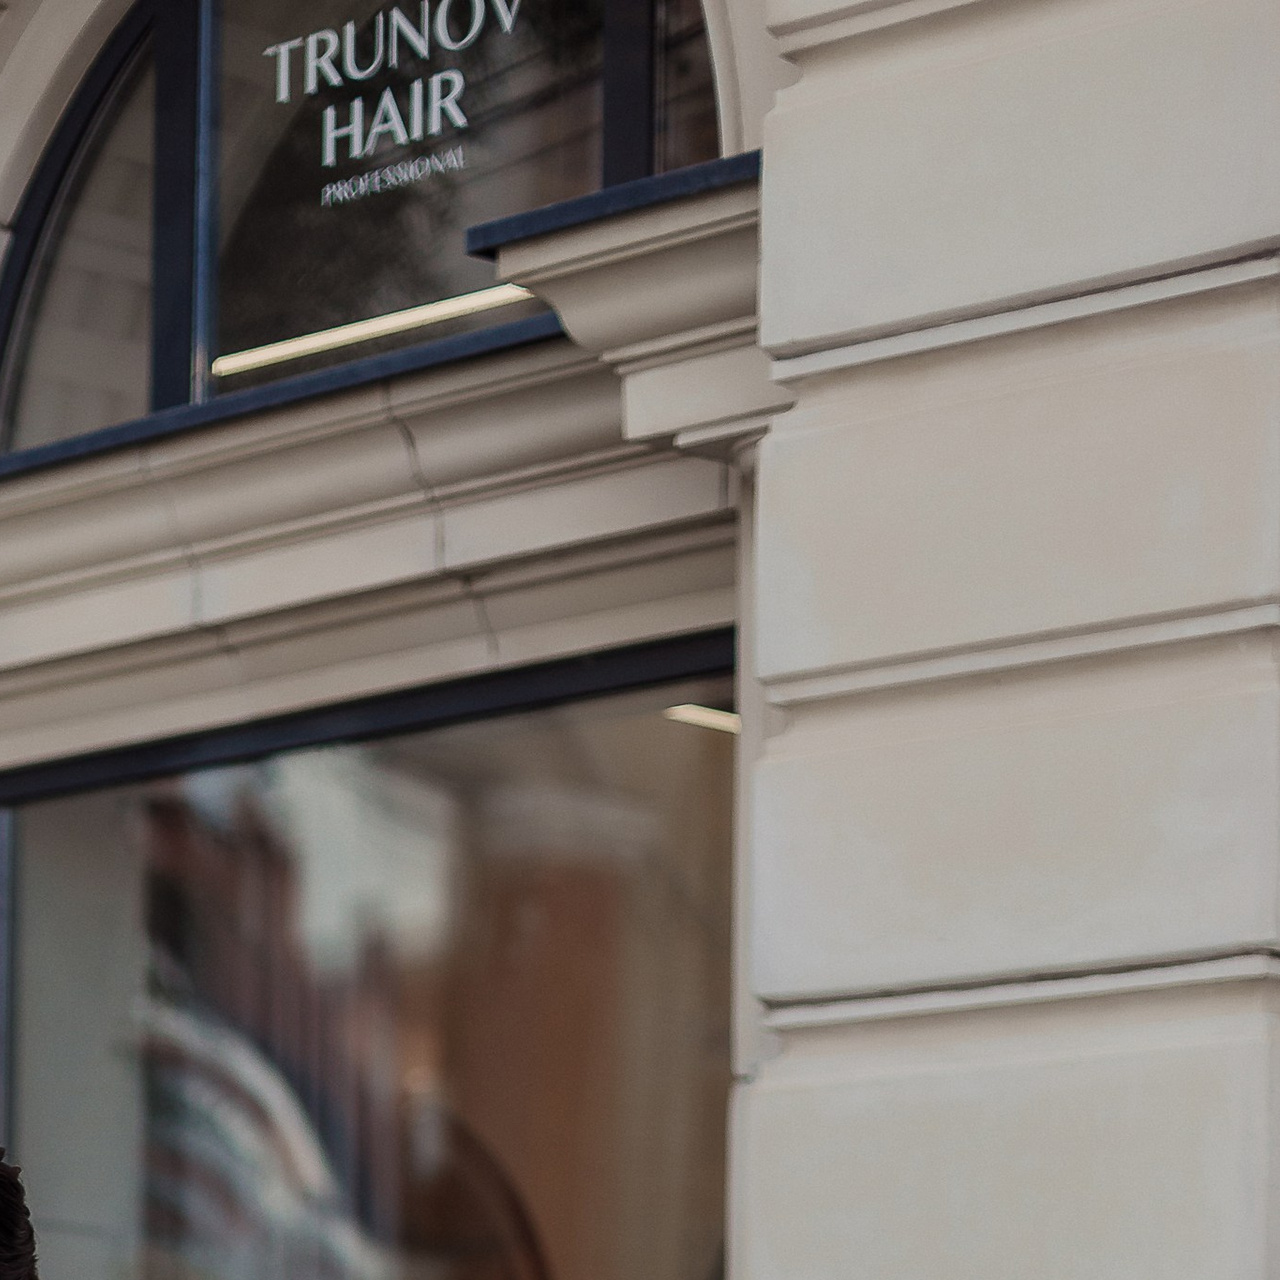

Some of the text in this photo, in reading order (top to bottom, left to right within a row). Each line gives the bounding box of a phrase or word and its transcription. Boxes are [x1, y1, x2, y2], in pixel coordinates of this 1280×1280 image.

[263, 0, 519, 103] TRUNOV
[322, 69, 468, 167] HAIR
[321, 145, 464, 206] PROFESSIONAL
